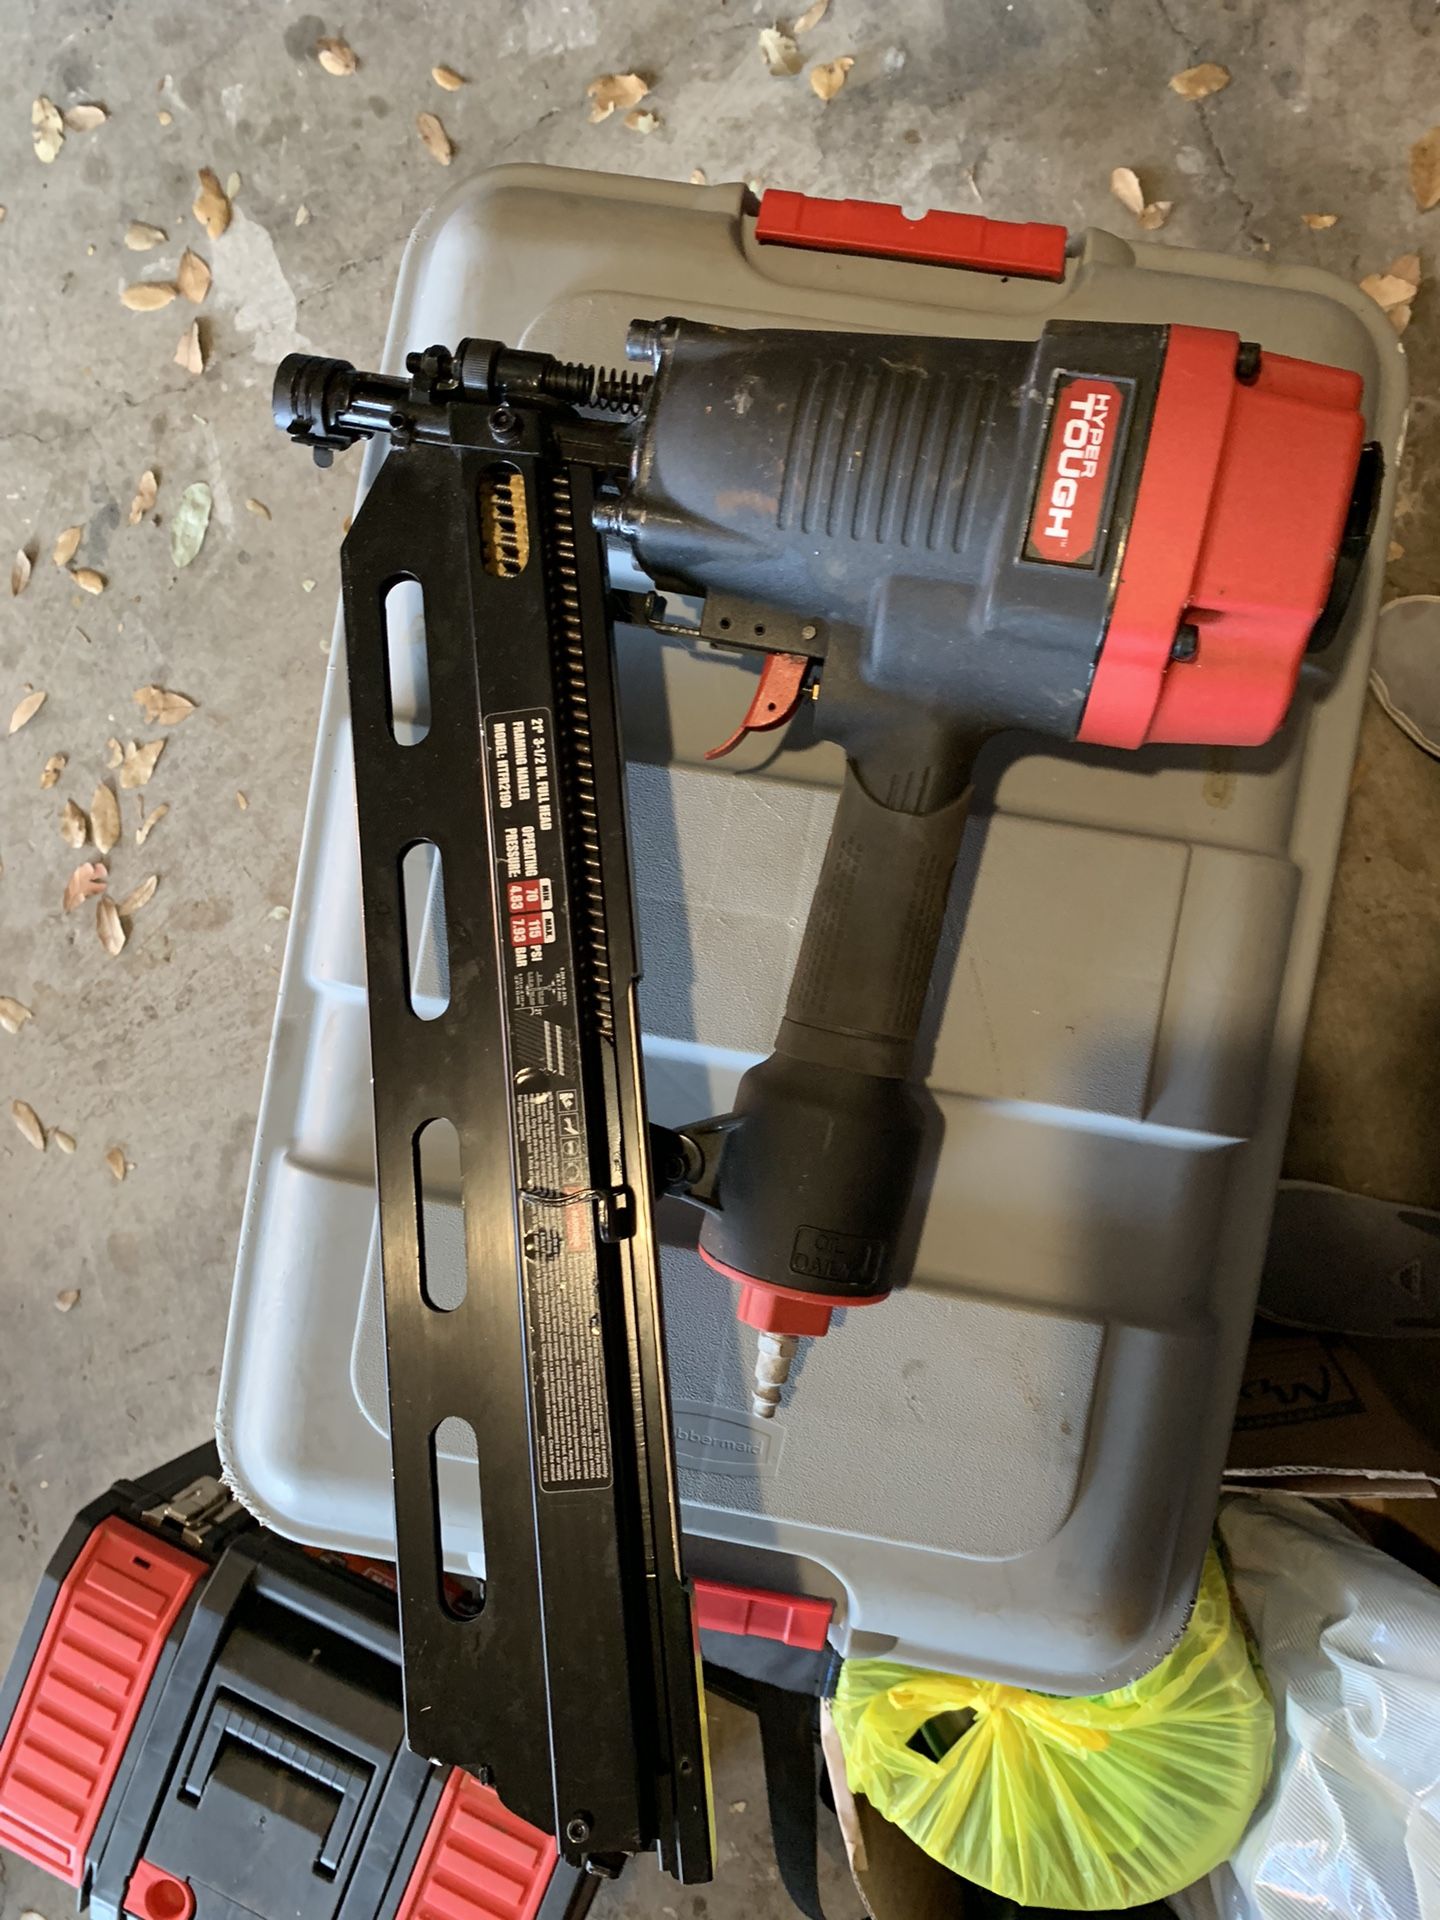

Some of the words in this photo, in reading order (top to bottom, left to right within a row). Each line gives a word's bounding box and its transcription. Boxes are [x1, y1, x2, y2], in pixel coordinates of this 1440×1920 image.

[1081, 393, 1112, 478] HYPER
[1044, 393, 1096, 538] TOUGH
[493, 723, 508, 758] MODEL:
[513, 721, 528, 765] FRAMING
[532, 738, 546, 764] 3-1/2
[496, 760, 512, 808] HTFR2190
[516, 767, 530, 800] NAILER
[536, 766, 548, 779] IN.
[536, 781, 550, 803] FULL
[539, 804, 552, 830] HEAD
[504, 828, 521, 878] PRESSURE:
[522, 826, 538, 877] OPERATING
[510, 885, 524, 910] 4.83
[525, 888, 539, 902] 70
[512, 918, 527, 943] 7.93
[527, 919, 541, 938] 115
[515, 946, 528, 967] BAR
[530, 944, 543, 962] PSI
